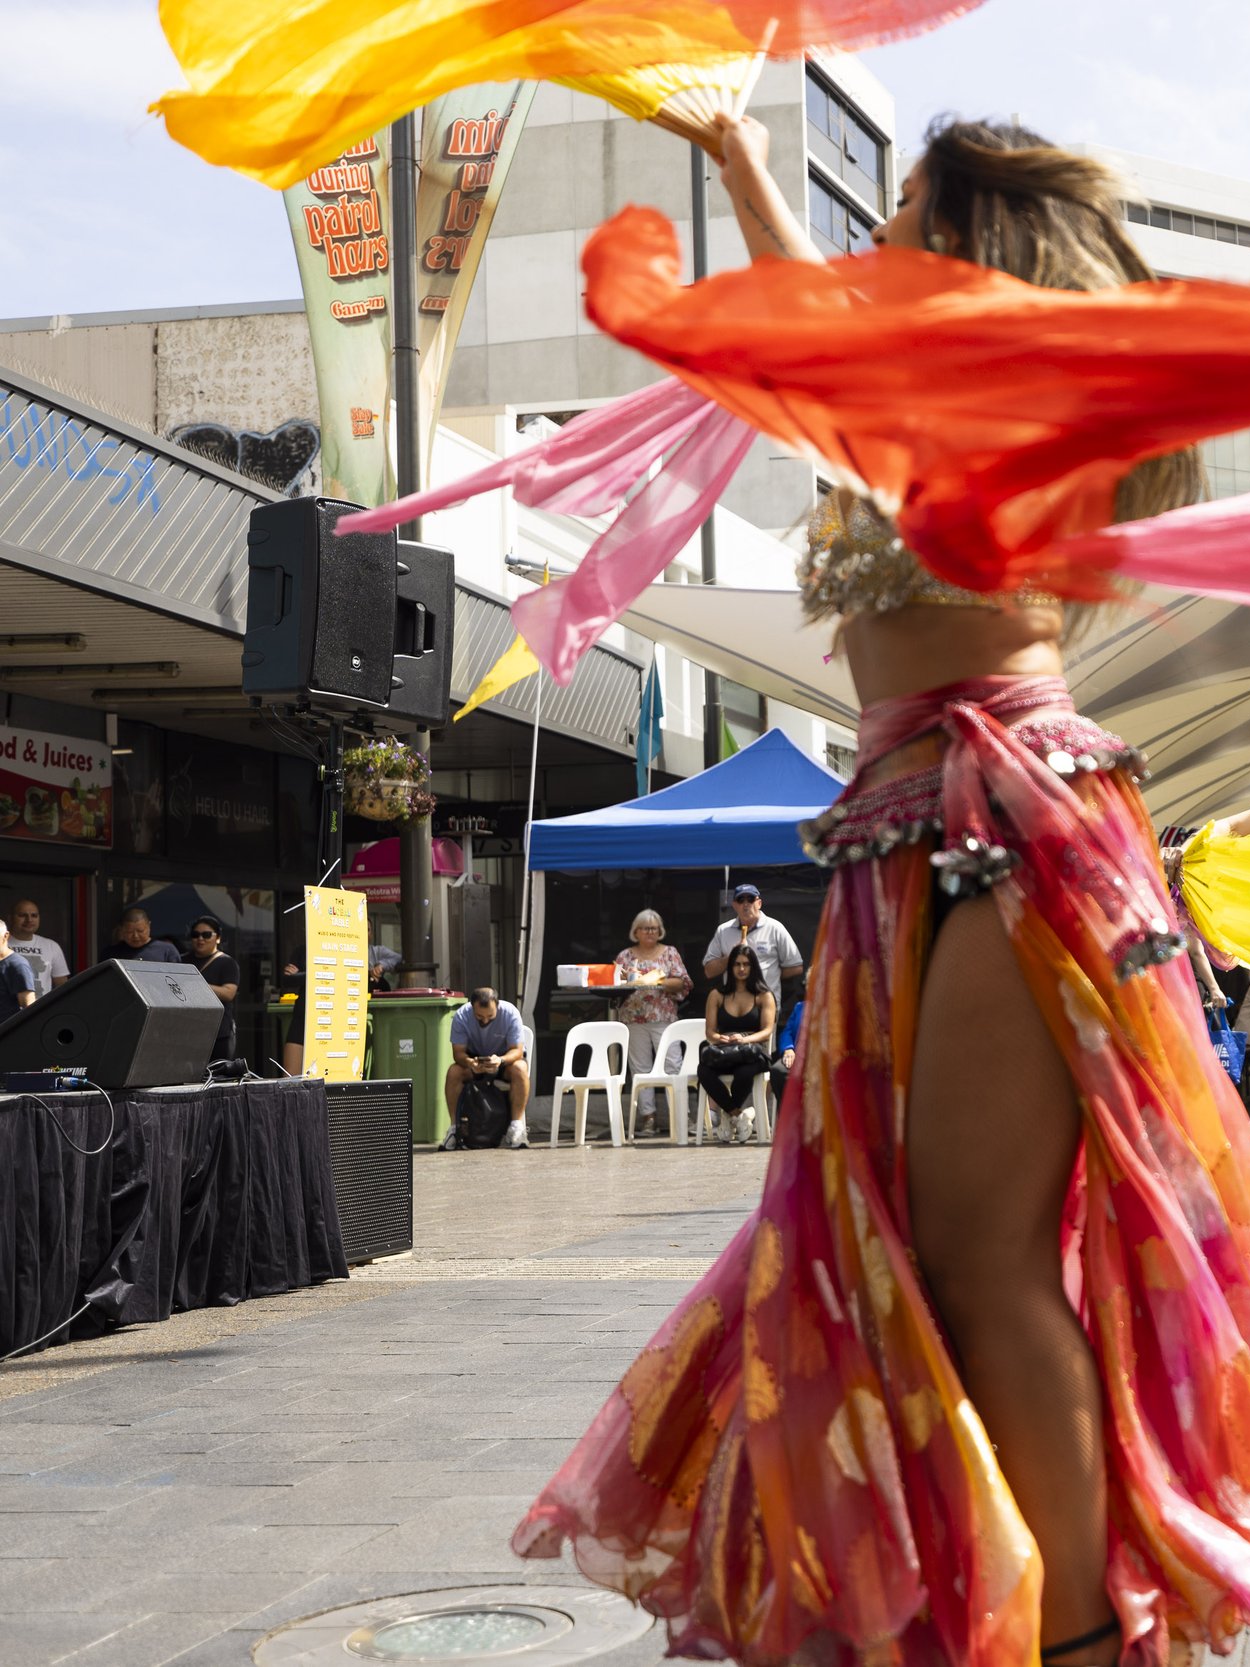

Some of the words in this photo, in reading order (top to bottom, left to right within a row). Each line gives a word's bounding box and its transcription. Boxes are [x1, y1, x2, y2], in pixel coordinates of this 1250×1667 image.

[303, 189, 380, 246] patrol
[324, 235, 388, 277] hours
[23, 738, 37, 764] &
[43, 742, 93, 772] Juices
